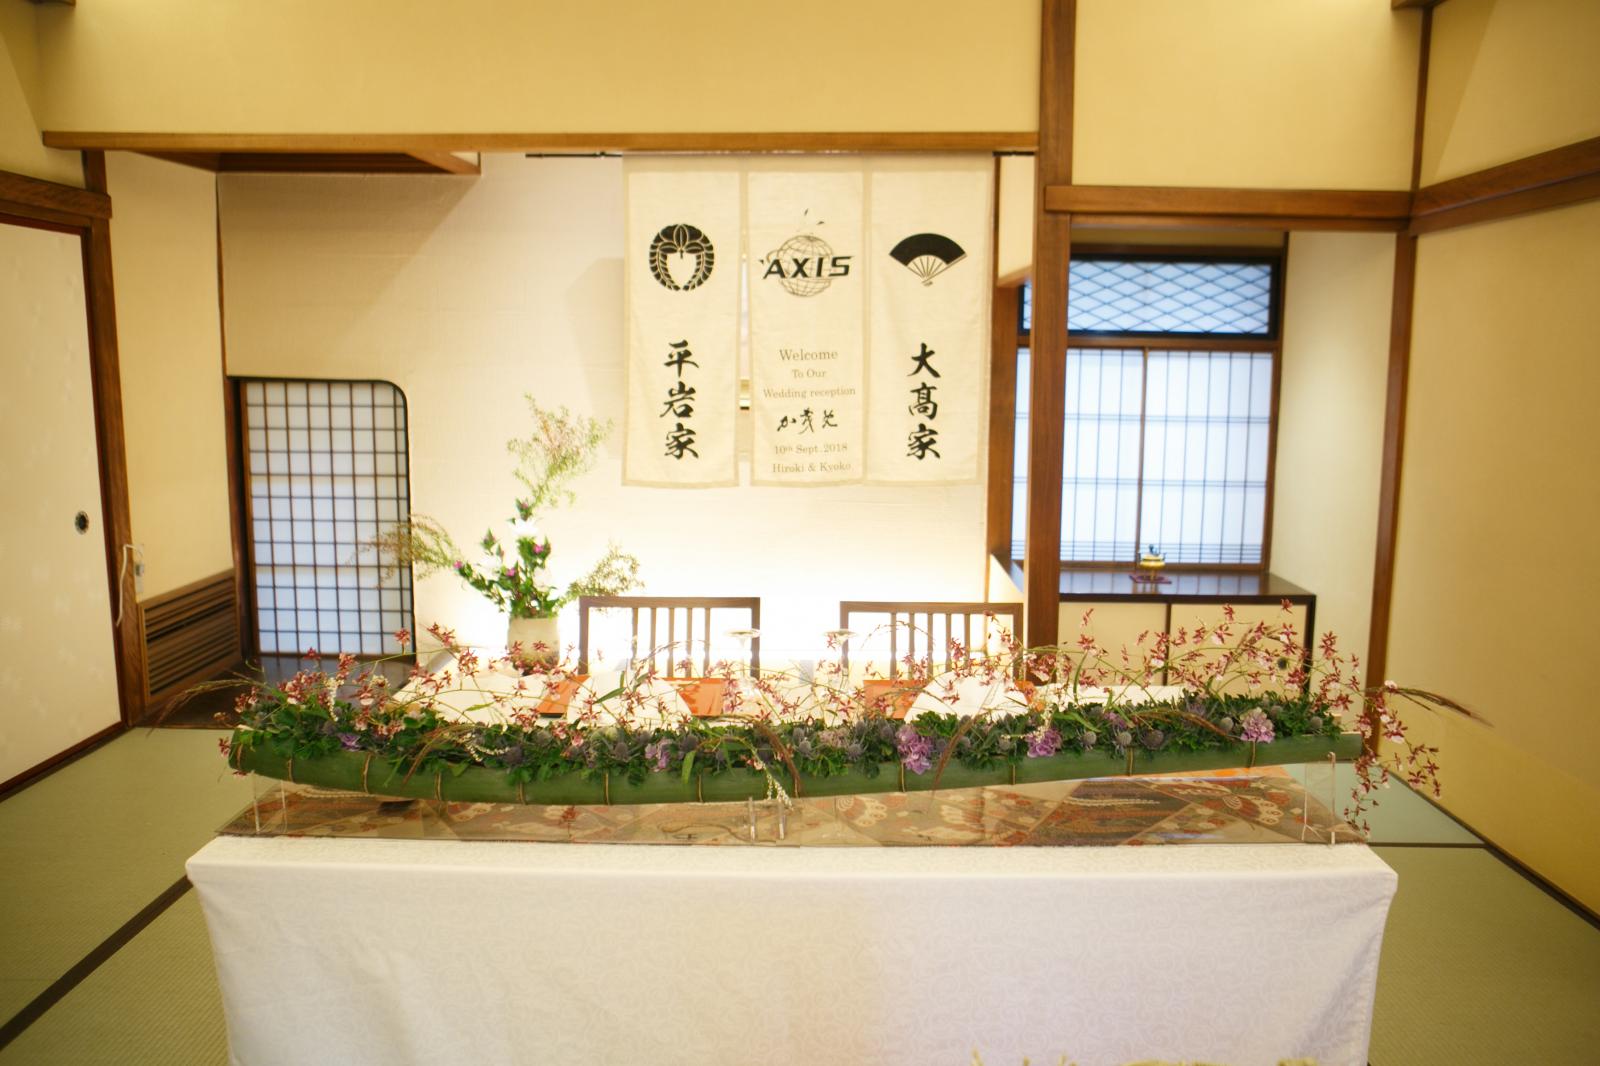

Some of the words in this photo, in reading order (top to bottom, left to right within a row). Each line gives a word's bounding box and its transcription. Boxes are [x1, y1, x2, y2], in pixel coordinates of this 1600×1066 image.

[763, 256, 853, 279] AXIS
[780, 349, 838, 361] Welcome
[792, 369, 804, 379] To
[806, 368, 827, 378] Our
[763, 388, 807, 399] Wedding
[810, 386, 856, 399] reception
[660, 340, 699, 460] 平岩家
[823, 442, 848, 453] 2018
[773, 463, 804, 473] Hiroki
[808, 463, 816, 473] &
[820, 461, 852, 473] Kyoko
